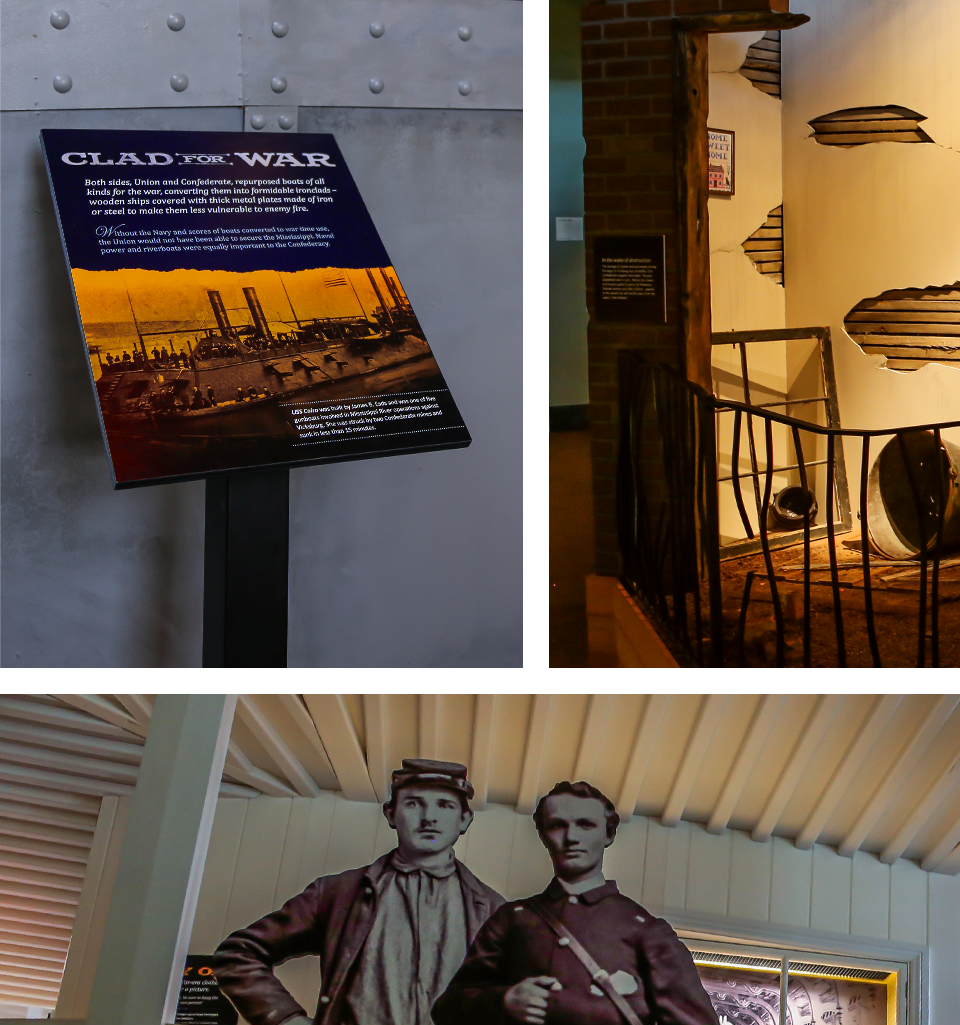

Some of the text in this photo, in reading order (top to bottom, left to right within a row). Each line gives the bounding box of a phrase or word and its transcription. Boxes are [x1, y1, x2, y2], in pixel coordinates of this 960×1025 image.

[709, 143, 730, 151] WEET
[61, 152, 336, 167] CLAD FOR WAR
[181, 178, 233, 186] Confederate,
[306, 178, 313, 186] of
[112, 188, 125, 197] for
[165, 188, 208, 196] converting
[251, 187, 294, 195] formidable
[127, 198, 149, 206] ships
[190, 206, 205, 214] less
[292, 205, 308, 213] fire.
[198, 966, 213, 976] O
